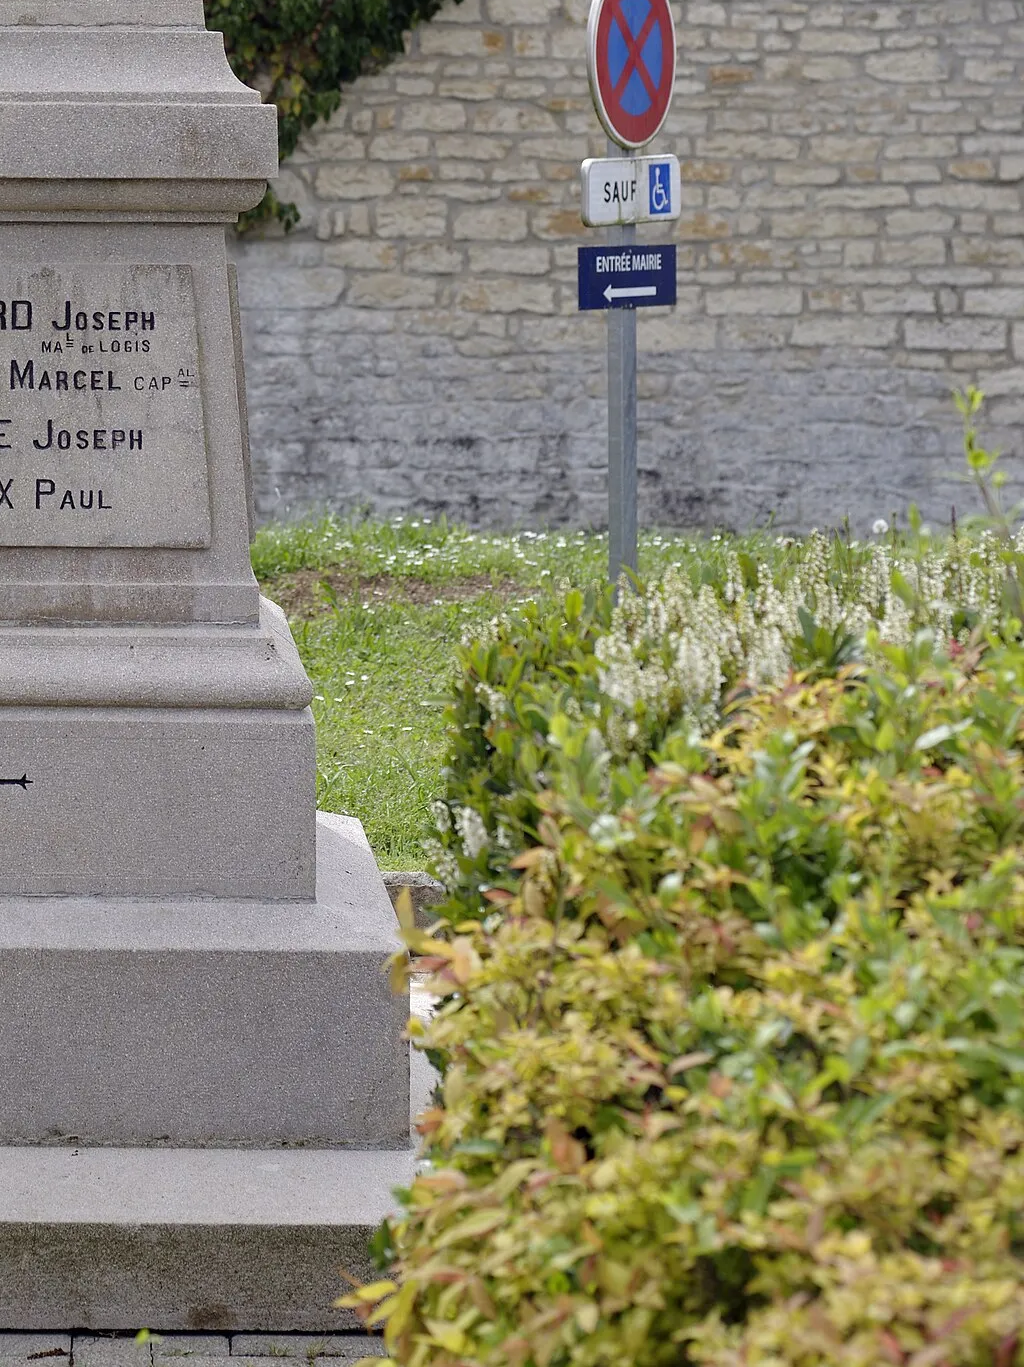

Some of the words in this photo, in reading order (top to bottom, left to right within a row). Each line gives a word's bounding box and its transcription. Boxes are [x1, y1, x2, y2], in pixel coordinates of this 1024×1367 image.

[603, 180, 637, 203] SAUF
[596, 252, 631, 273] ENTRÉE
[632, 253, 662, 271] MAIRIE
[99, 340, 151, 353] LOGIS
